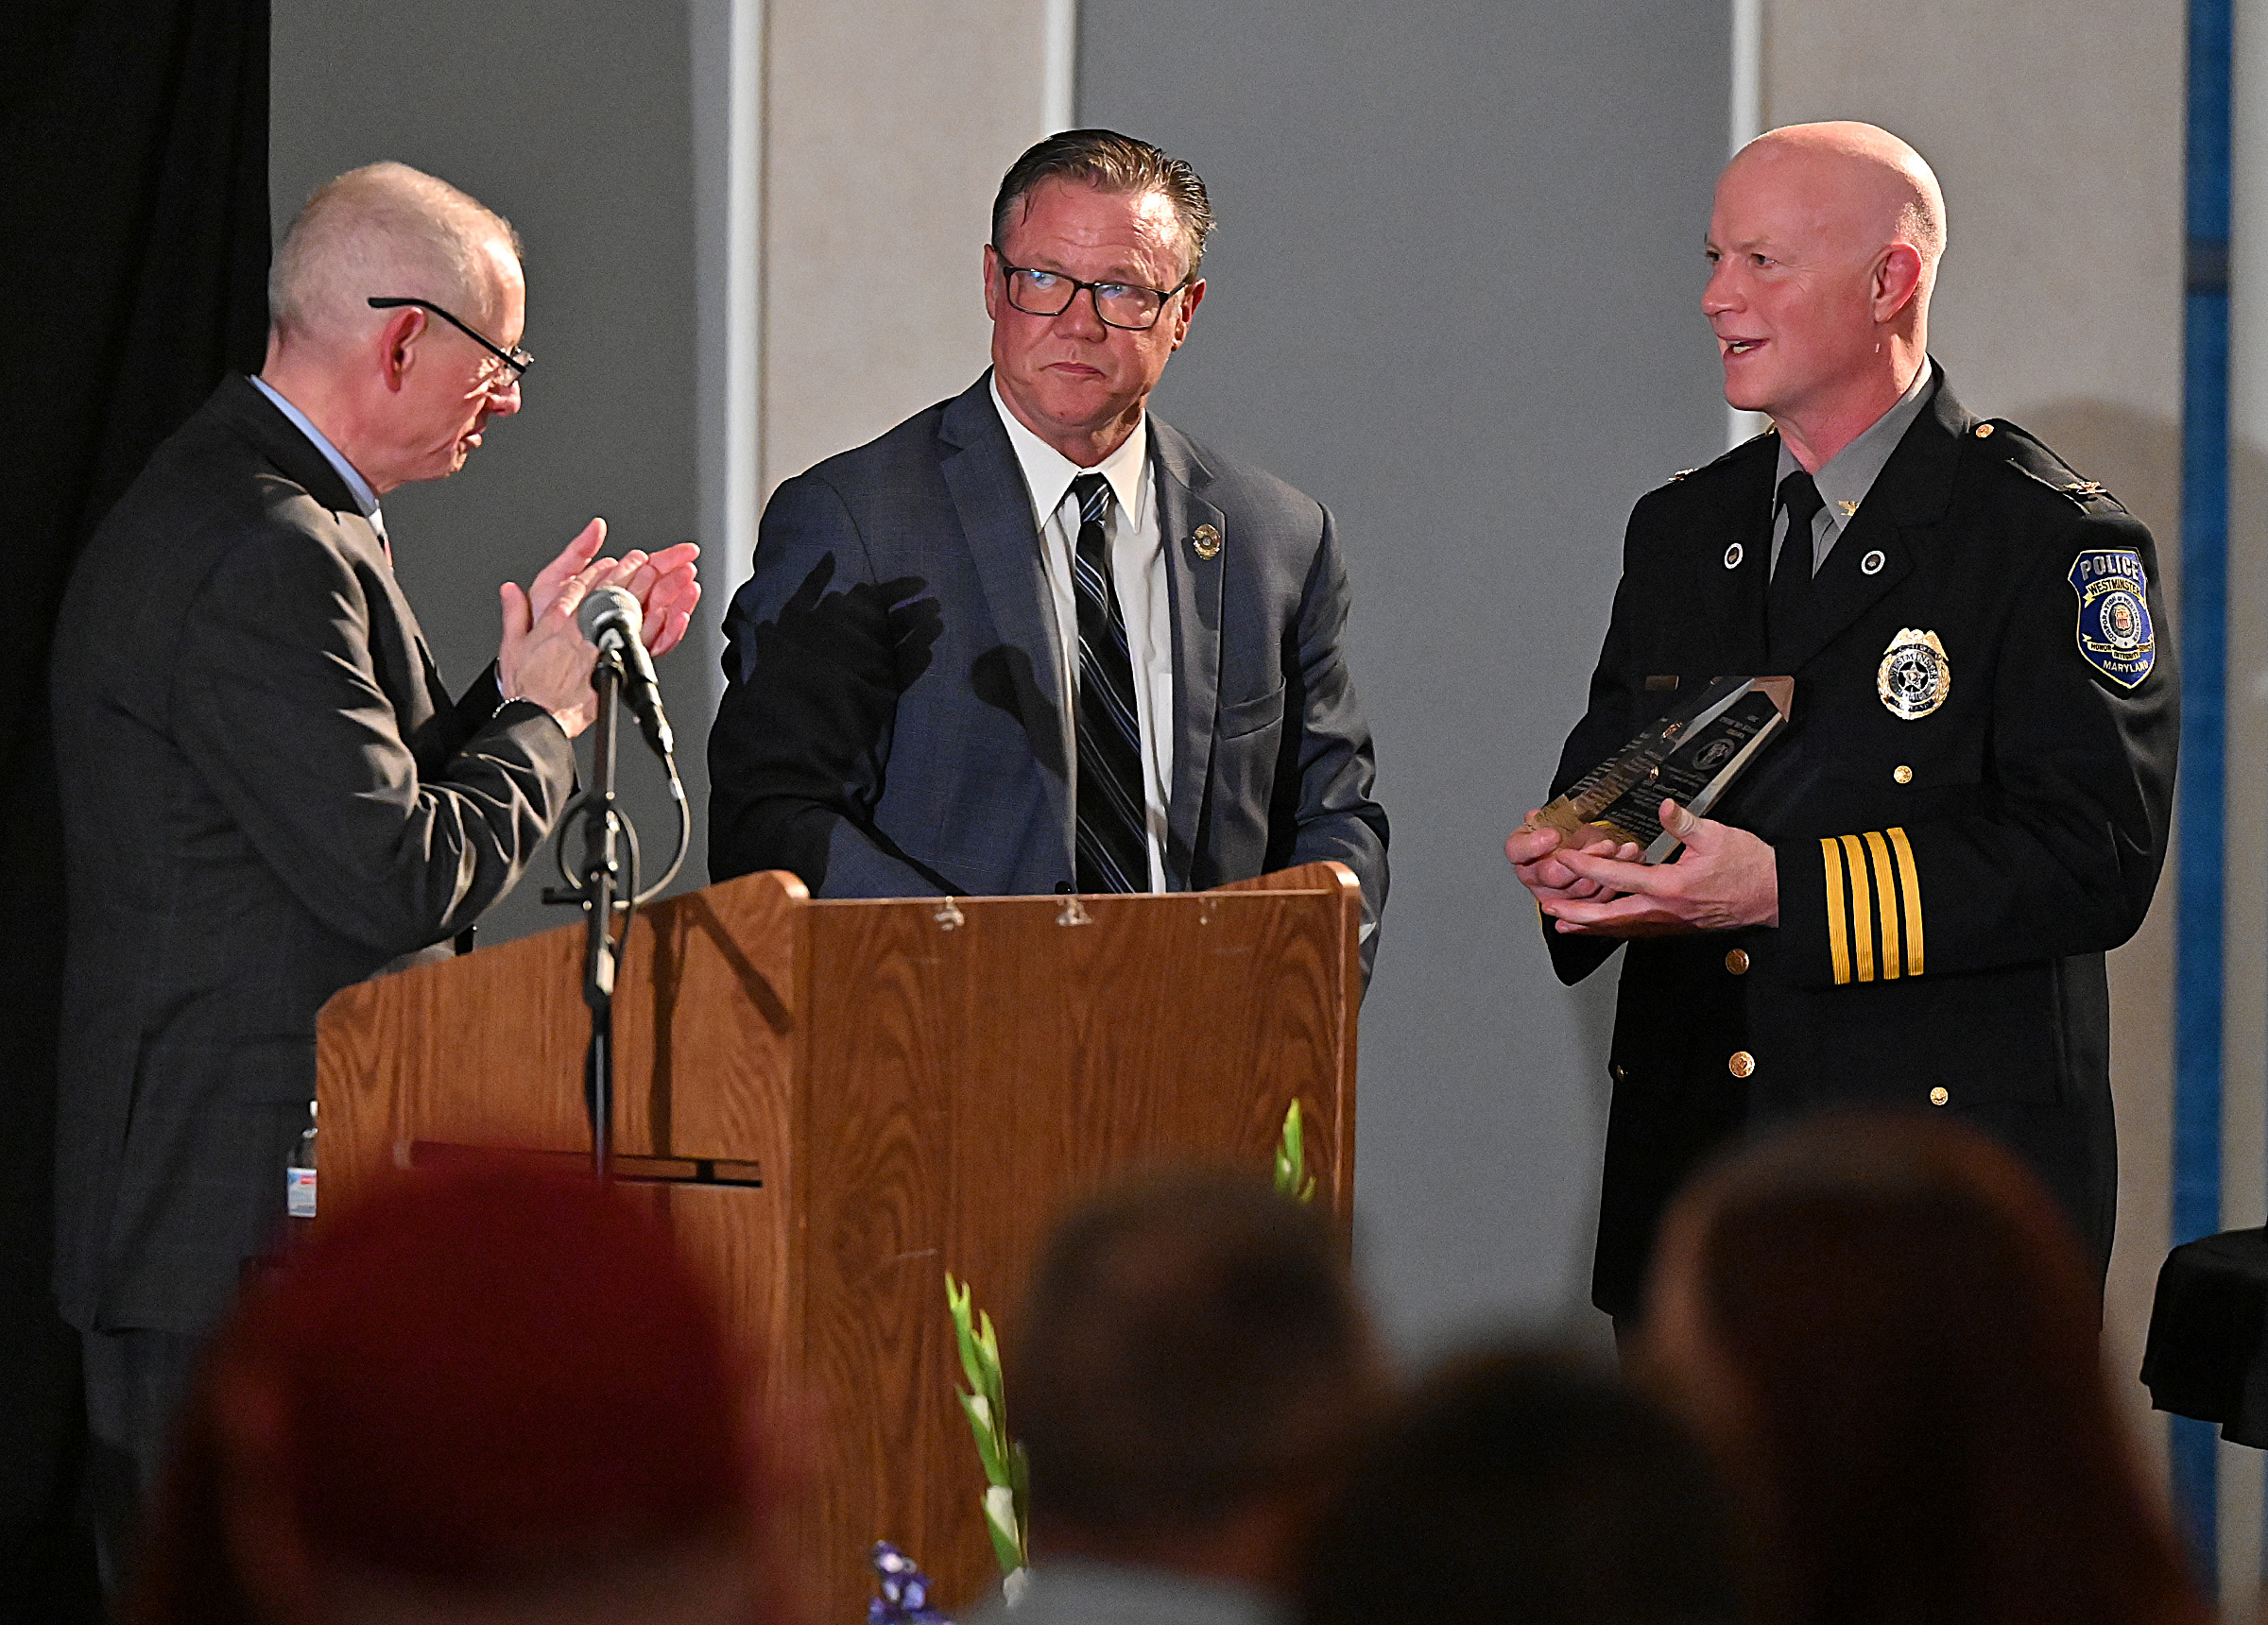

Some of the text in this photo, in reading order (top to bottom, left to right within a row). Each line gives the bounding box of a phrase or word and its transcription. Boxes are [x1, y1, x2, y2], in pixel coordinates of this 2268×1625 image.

[2079, 555, 2139, 582] POLICE
[2088, 578, 2140, 596] WESTMINSTER
[2102, 596, 2118, 642] CORPORATION
[2103, 659, 2149, 673] MARYLAND
